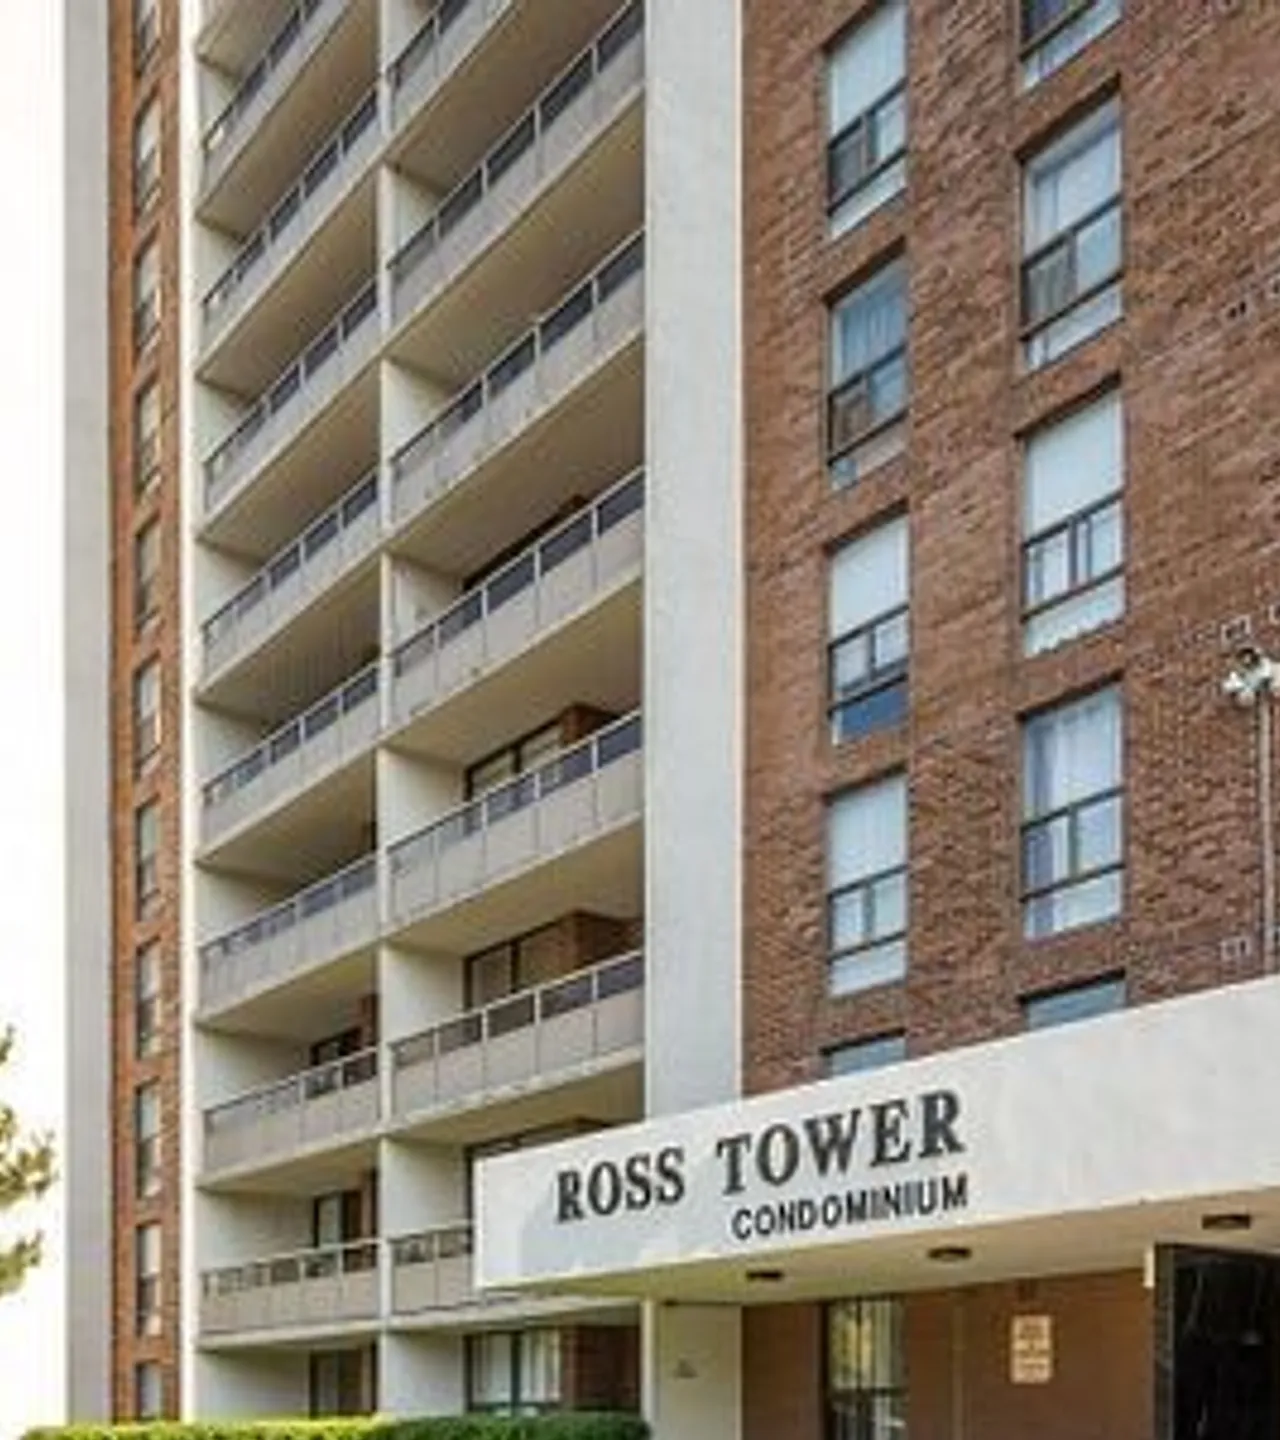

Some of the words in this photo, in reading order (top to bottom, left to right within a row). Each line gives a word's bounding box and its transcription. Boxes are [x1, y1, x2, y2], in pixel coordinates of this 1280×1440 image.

[556, 1146, 685, 1223] ROSS
[716, 1089, 966, 1196] TOWER
[731, 1172, 969, 1240] CONDOMINIUM
